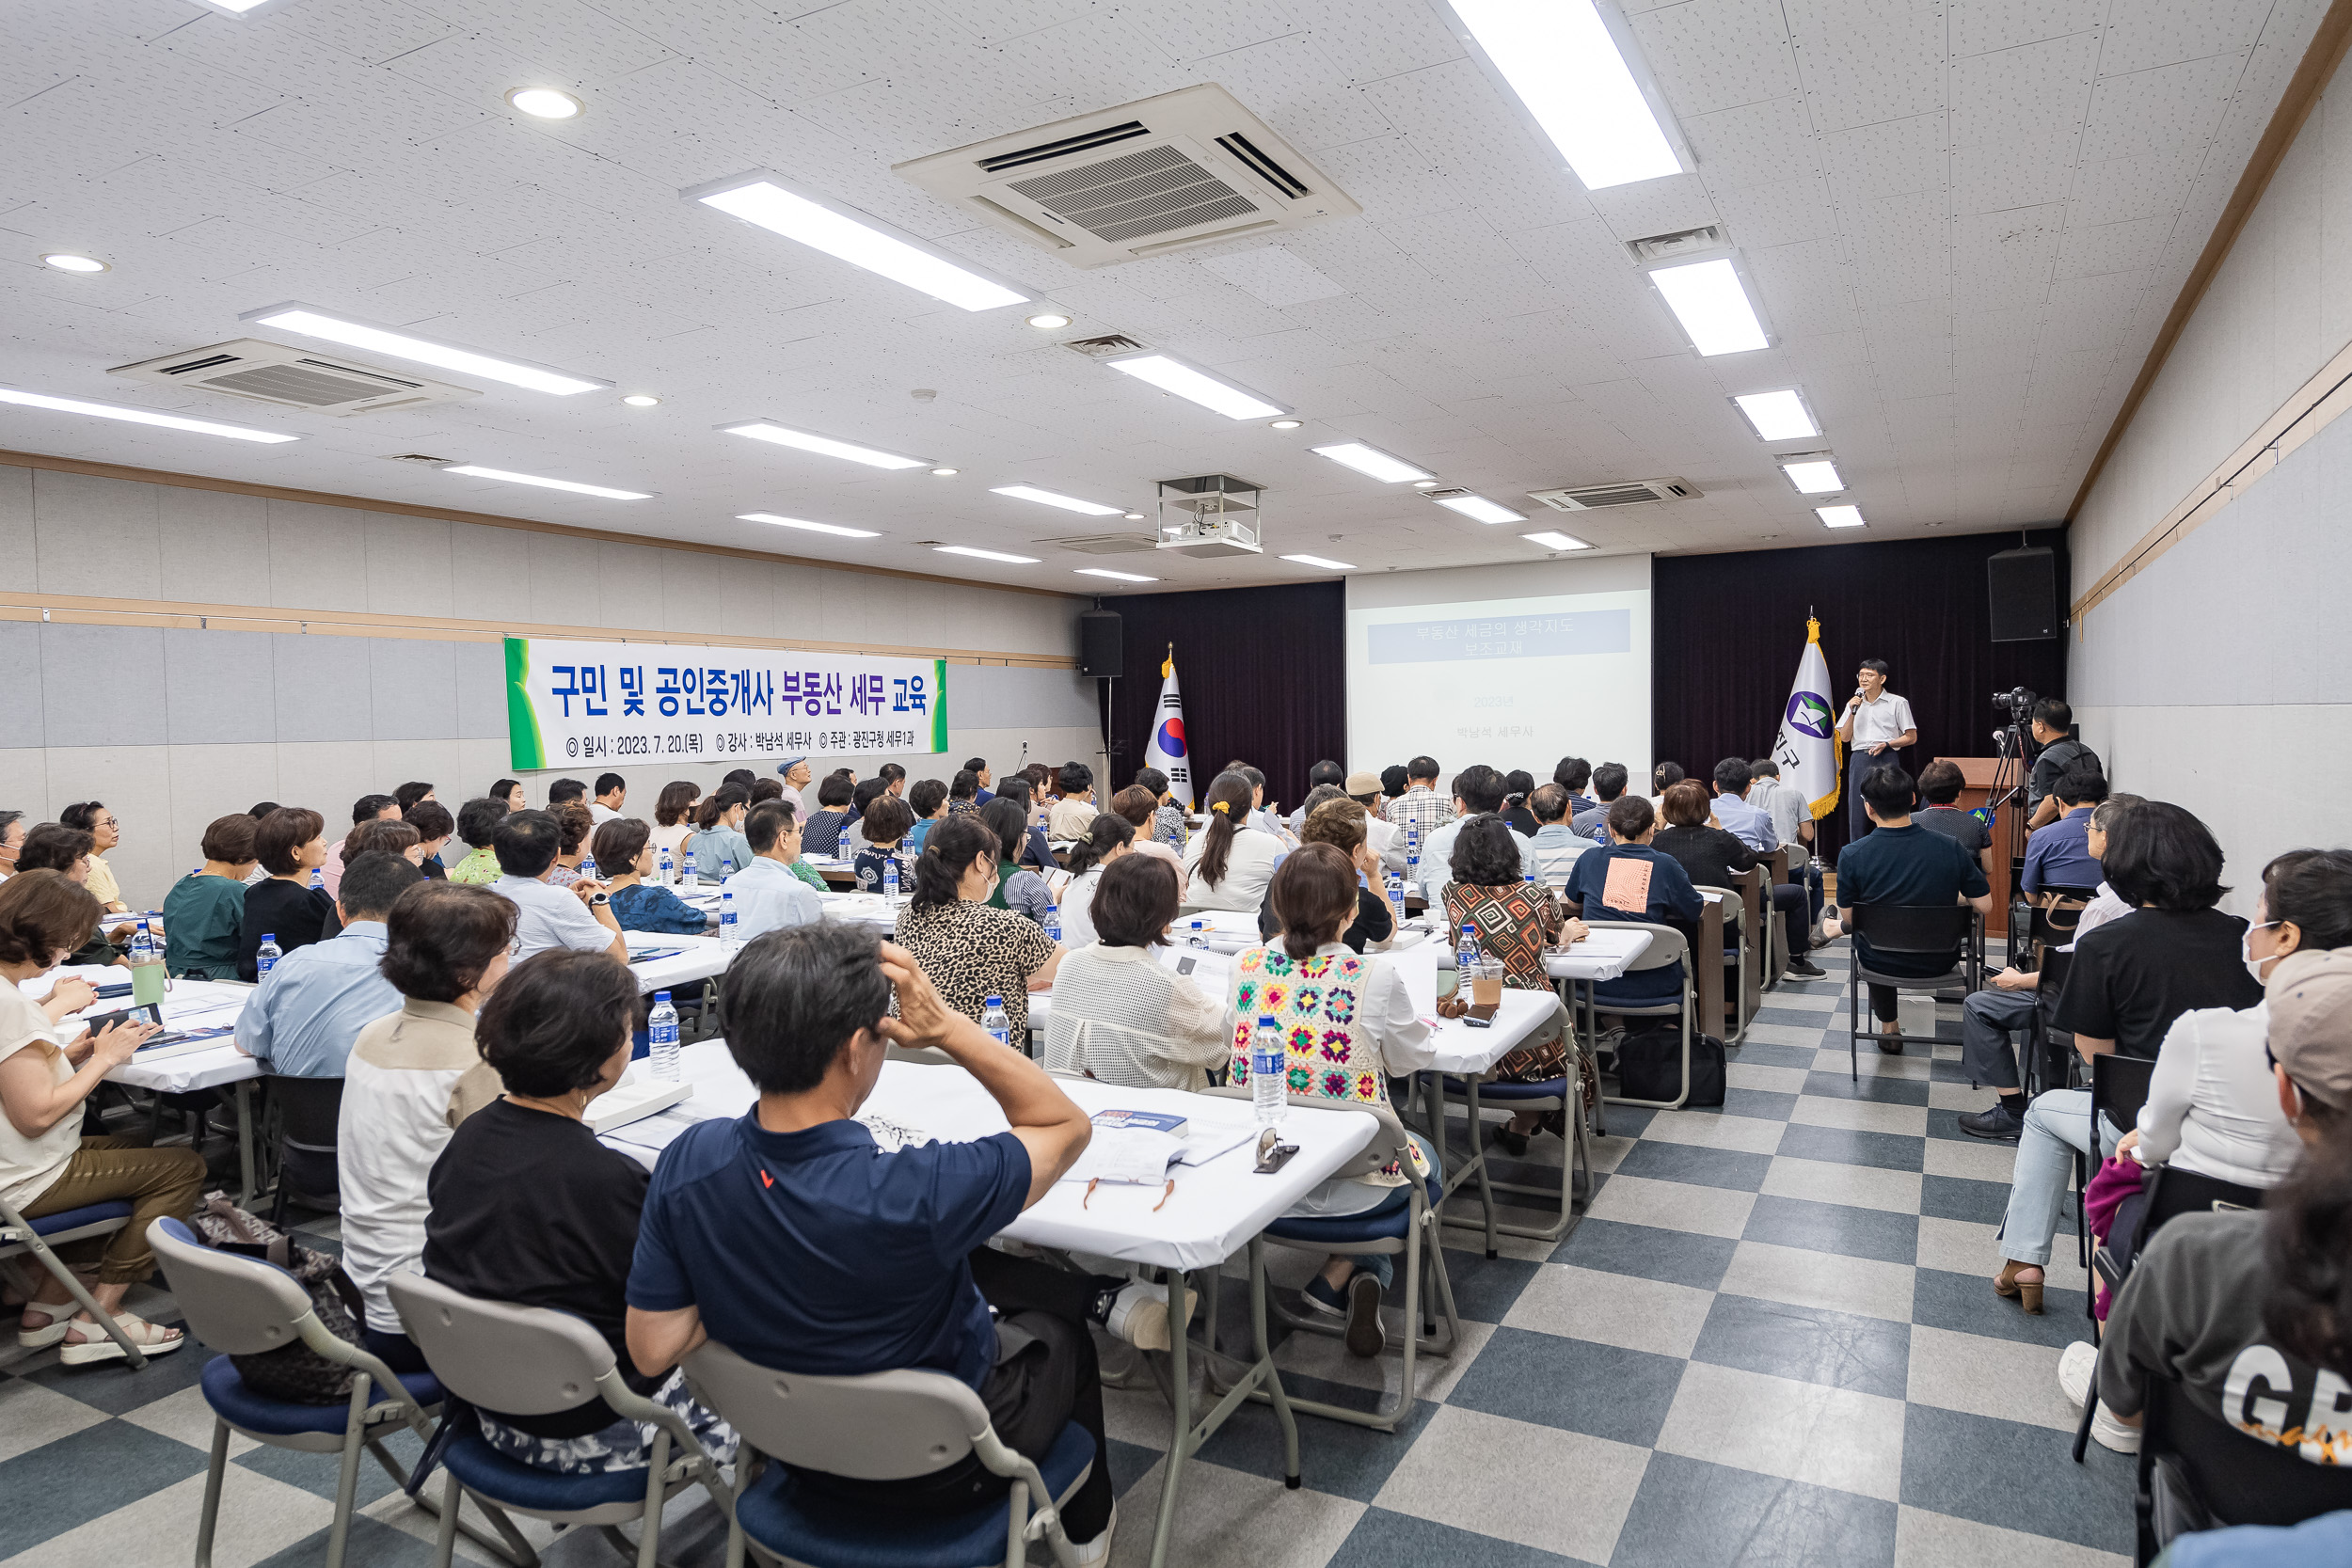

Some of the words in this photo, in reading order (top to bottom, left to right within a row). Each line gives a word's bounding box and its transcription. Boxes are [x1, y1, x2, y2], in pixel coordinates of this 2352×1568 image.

[1416, 625, 1459, 641] 부동산
[1464, 621, 1507, 640] 세금의
[1513, 617, 1575, 636] 생각지도
[1464, 640, 1523, 657] 보조교재
[552, 664, 608, 717] 구민
[620, 665, 644, 717] 및
[656, 667, 774, 718] 공인중개사
[783, 671, 843, 717] 부동산
[850, 673, 886, 716] 세무
[892, 674, 928, 715] 교육
[1472, 694, 1515, 709] 2023년
[1455, 724, 1493, 740] 박남석
[1497, 724, 1535, 739] 세무사
[582, 736, 607, 758] 일시
[617, 736, 651, 755] 2023.
[653, 735, 664, 753] 7.
[667, 733, 703, 754] 20.(목)
[727, 732, 748, 752] 강사
[755, 732, 784, 752] 박남석
[786, 731, 812, 751] 세무사
[830, 730, 847, 750] 주관
[852, 730, 884, 749] 광진구청
[885, 730, 914, 748] 세무1과
